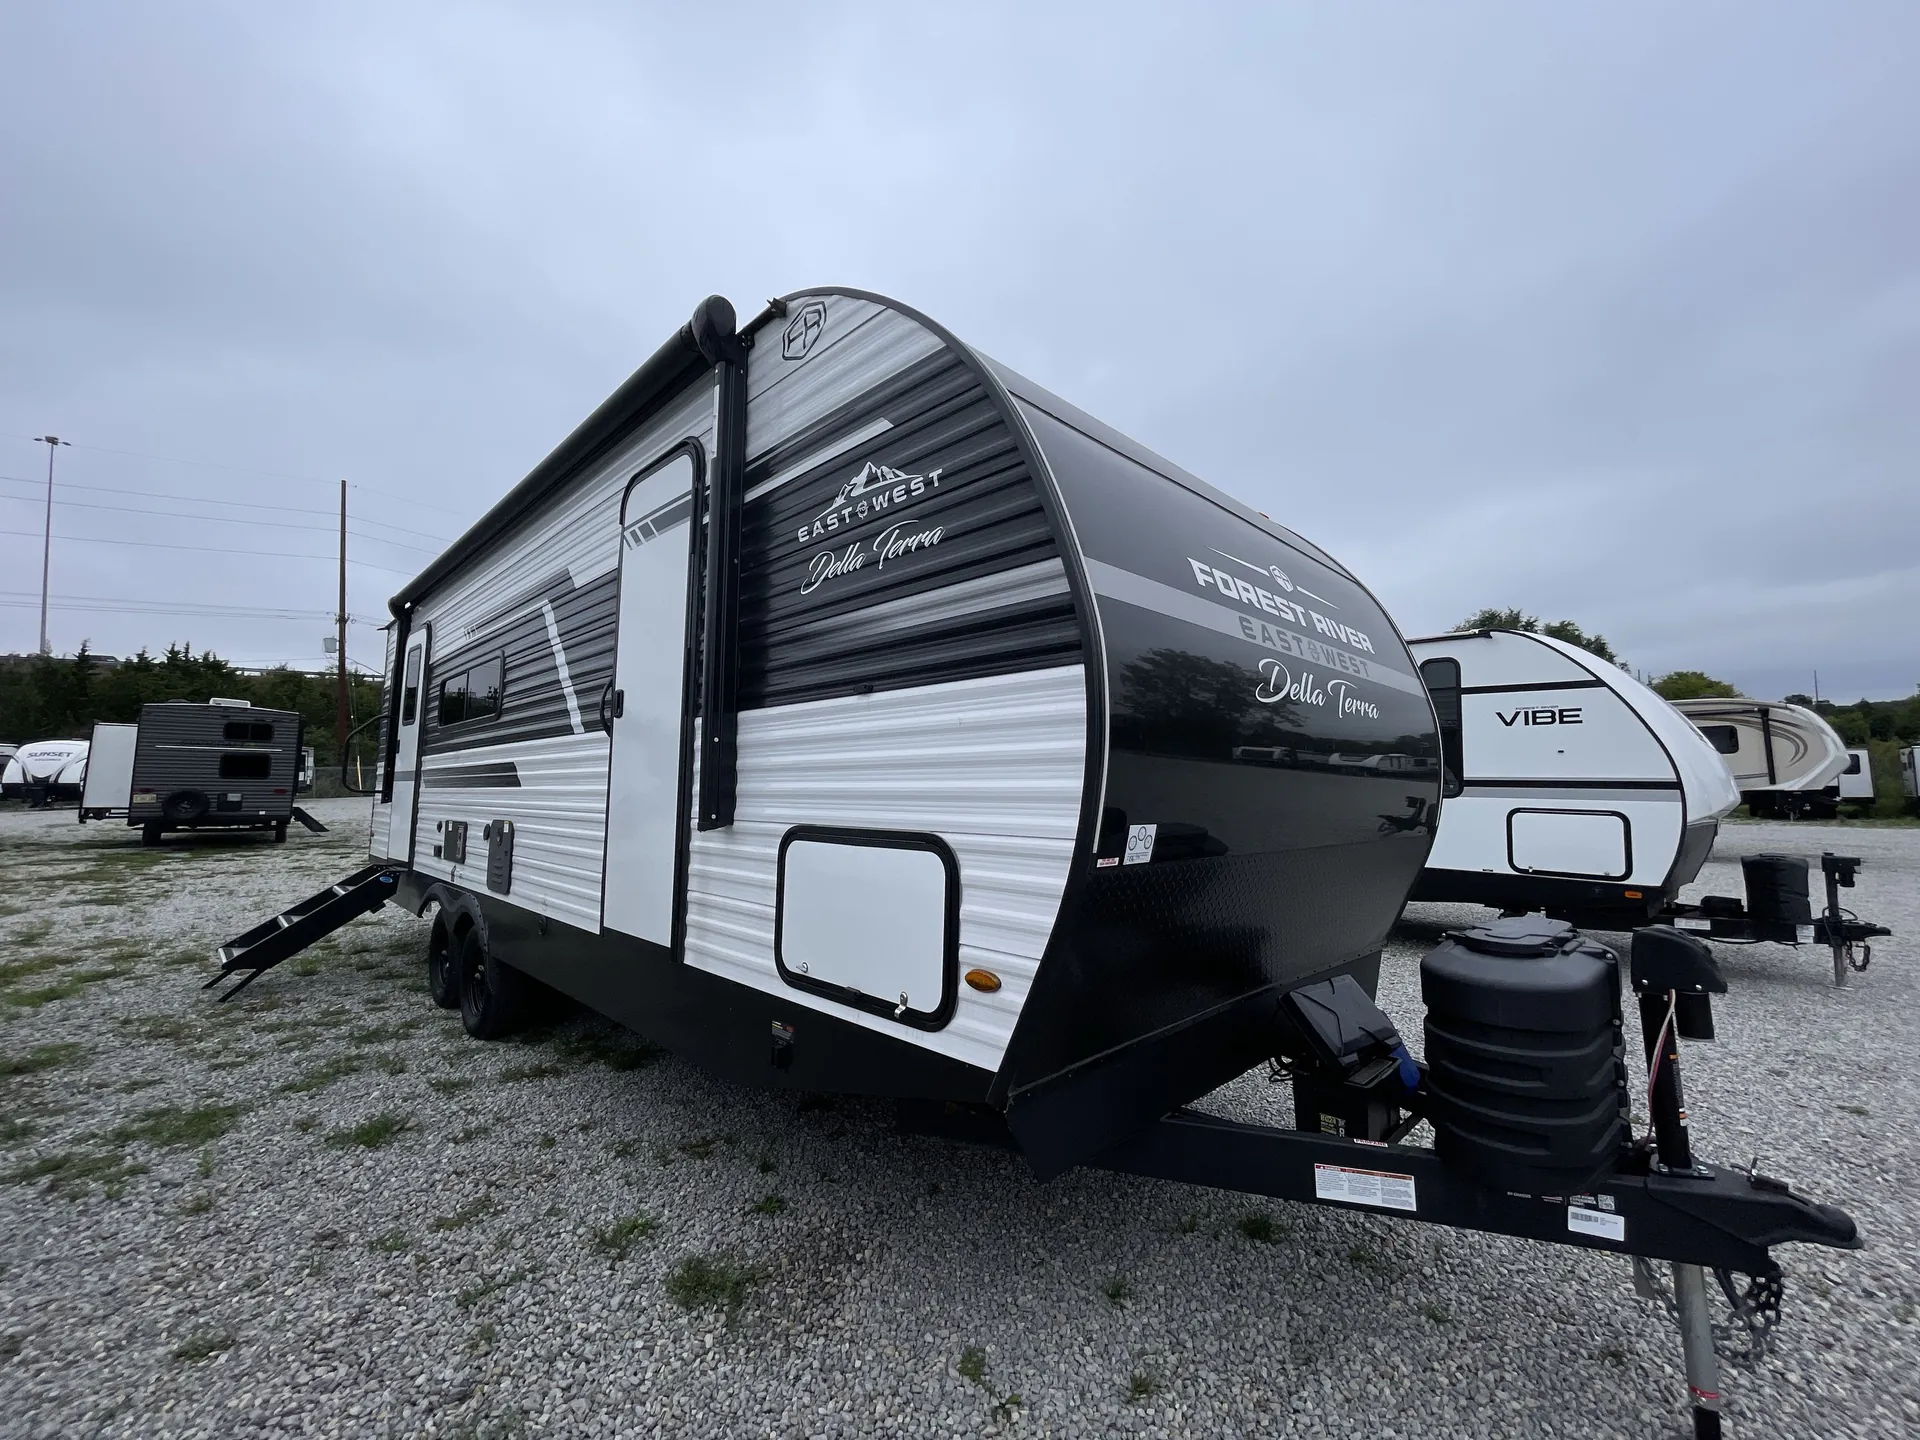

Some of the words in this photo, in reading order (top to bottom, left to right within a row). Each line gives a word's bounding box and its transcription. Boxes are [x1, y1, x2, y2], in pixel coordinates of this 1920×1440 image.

[797, 507, 854, 543] EAST
[872, 468, 944, 512] WEST
[800, 542, 867, 595] Della
[873, 519, 946, 570] Terra
[1187, 556, 1307, 628] FOREST
[1308, 609, 1376, 655] RIVER
[1238, 615, 1305, 657] EAST
[1319, 645, 1370, 678] WEST
[1255, 658, 1327, 706] Della
[1327, 679, 1380, 719] Terra
[1495, 708, 1583, 726] VIBE
